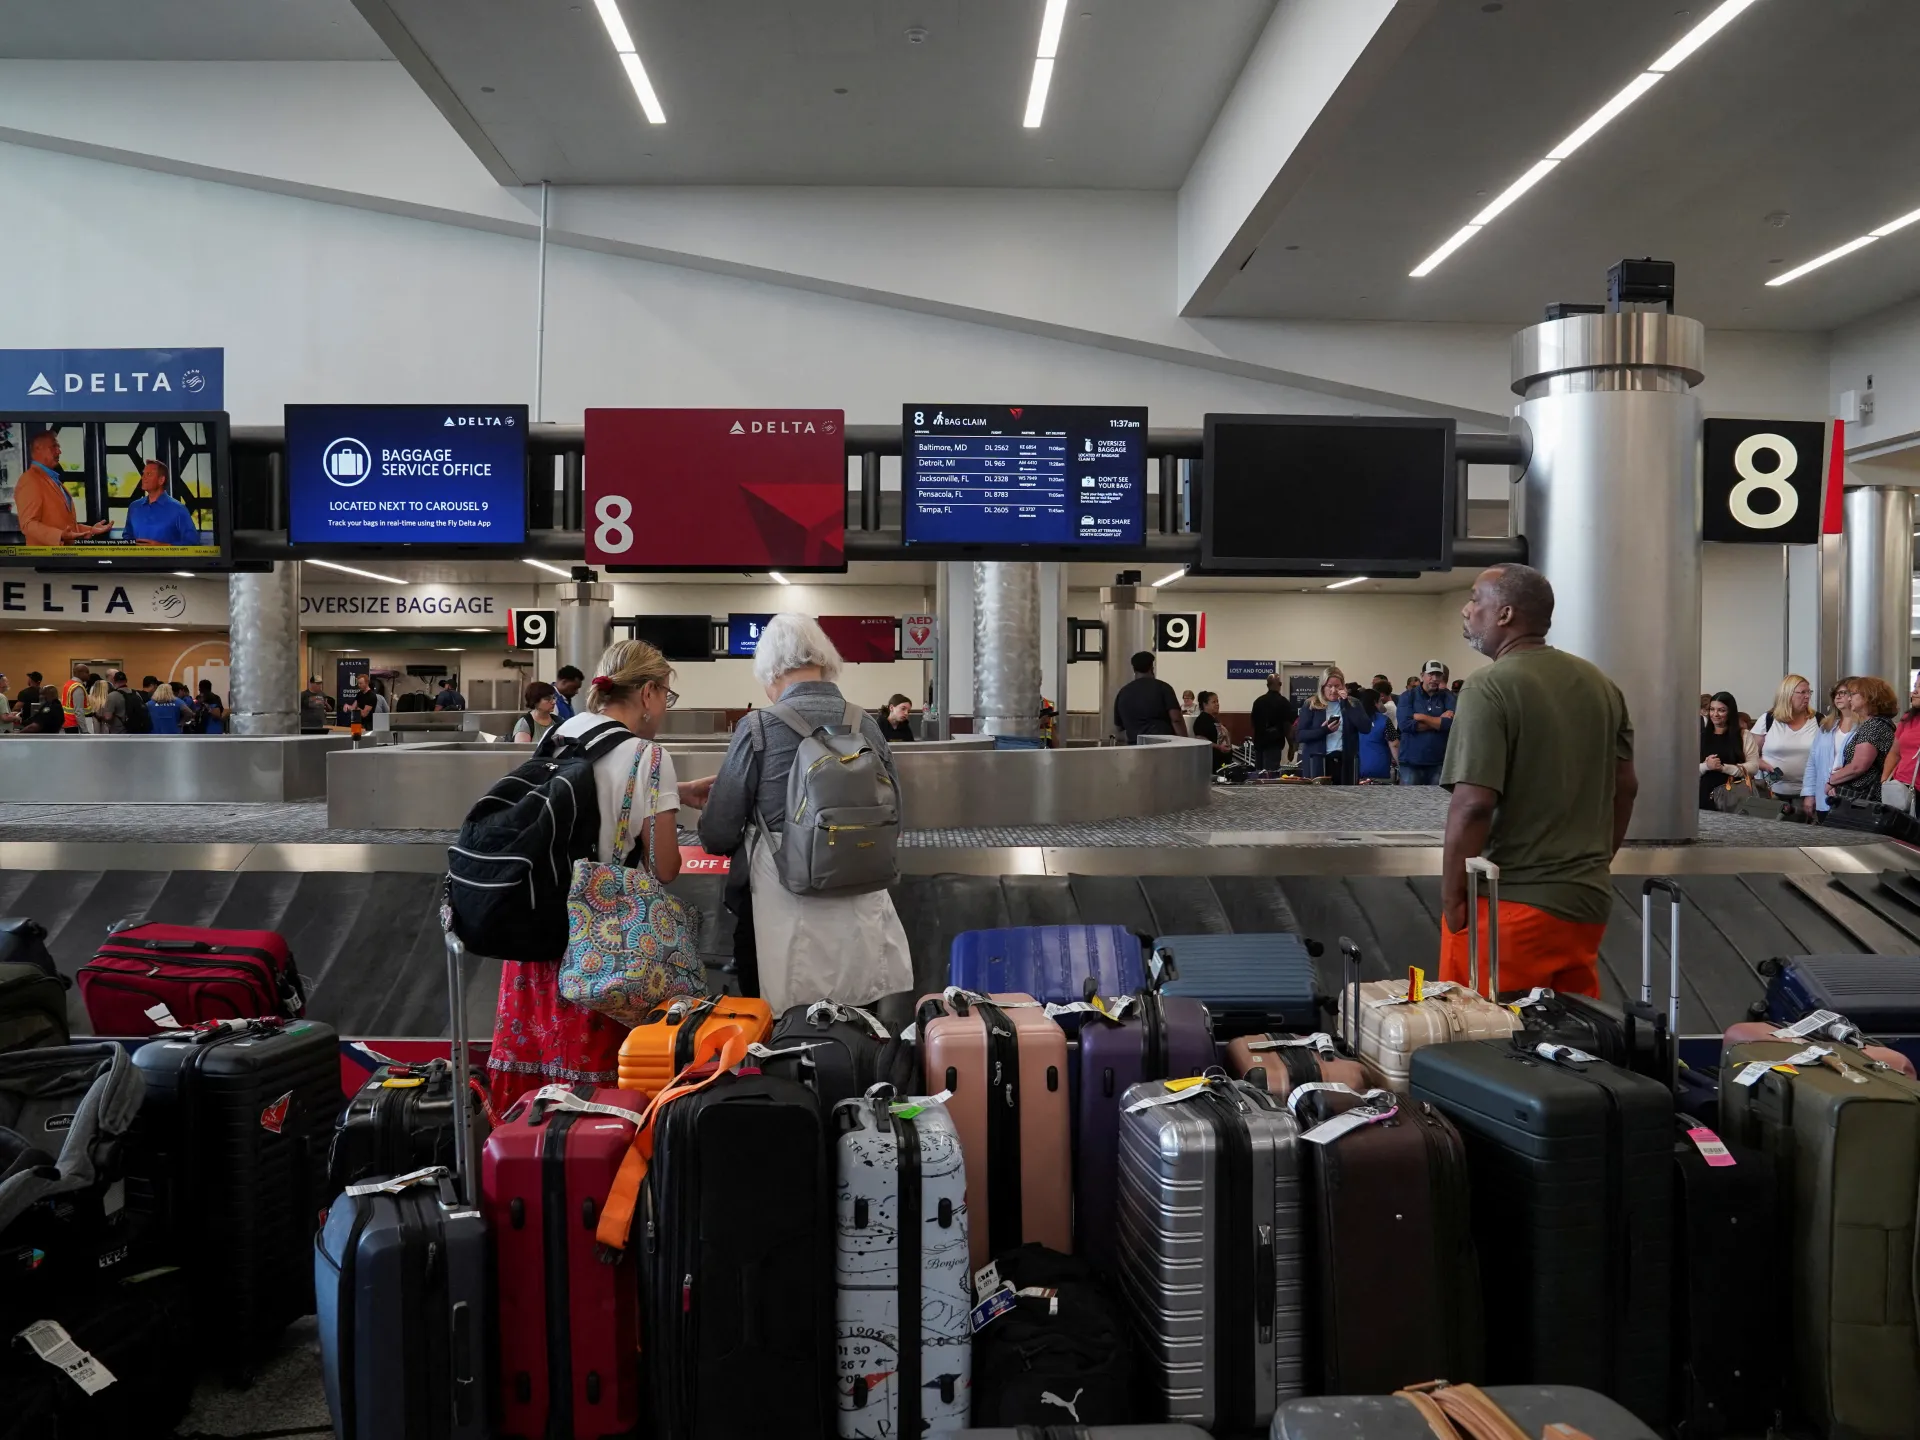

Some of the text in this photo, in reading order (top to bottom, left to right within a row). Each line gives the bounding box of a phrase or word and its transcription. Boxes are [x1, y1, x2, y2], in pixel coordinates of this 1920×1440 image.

[65, 372, 172, 392] DELTA
[459, 417, 501, 426] DELTA
[914, 412, 924, 425] 8
[751, 422, 816, 433] DELTA
[382, 449, 452, 462] BAGGAGE
[382, 463, 492, 476] SERVICE OFFICE
[1729, 433, 1798, 529] 8
[330, 502, 488, 511] LOCATED NEXT TO CAROUSEL 9
[594, 494, 634, 554] 8
[2, 582, 134, 614] ELTA
[300, 597, 494, 613] OVERSIZE BAGGAGE
[524, 614, 546, 645] 9
[1166, 618, 1190, 648] 9
[686, 860, 731, 868] OFF E
